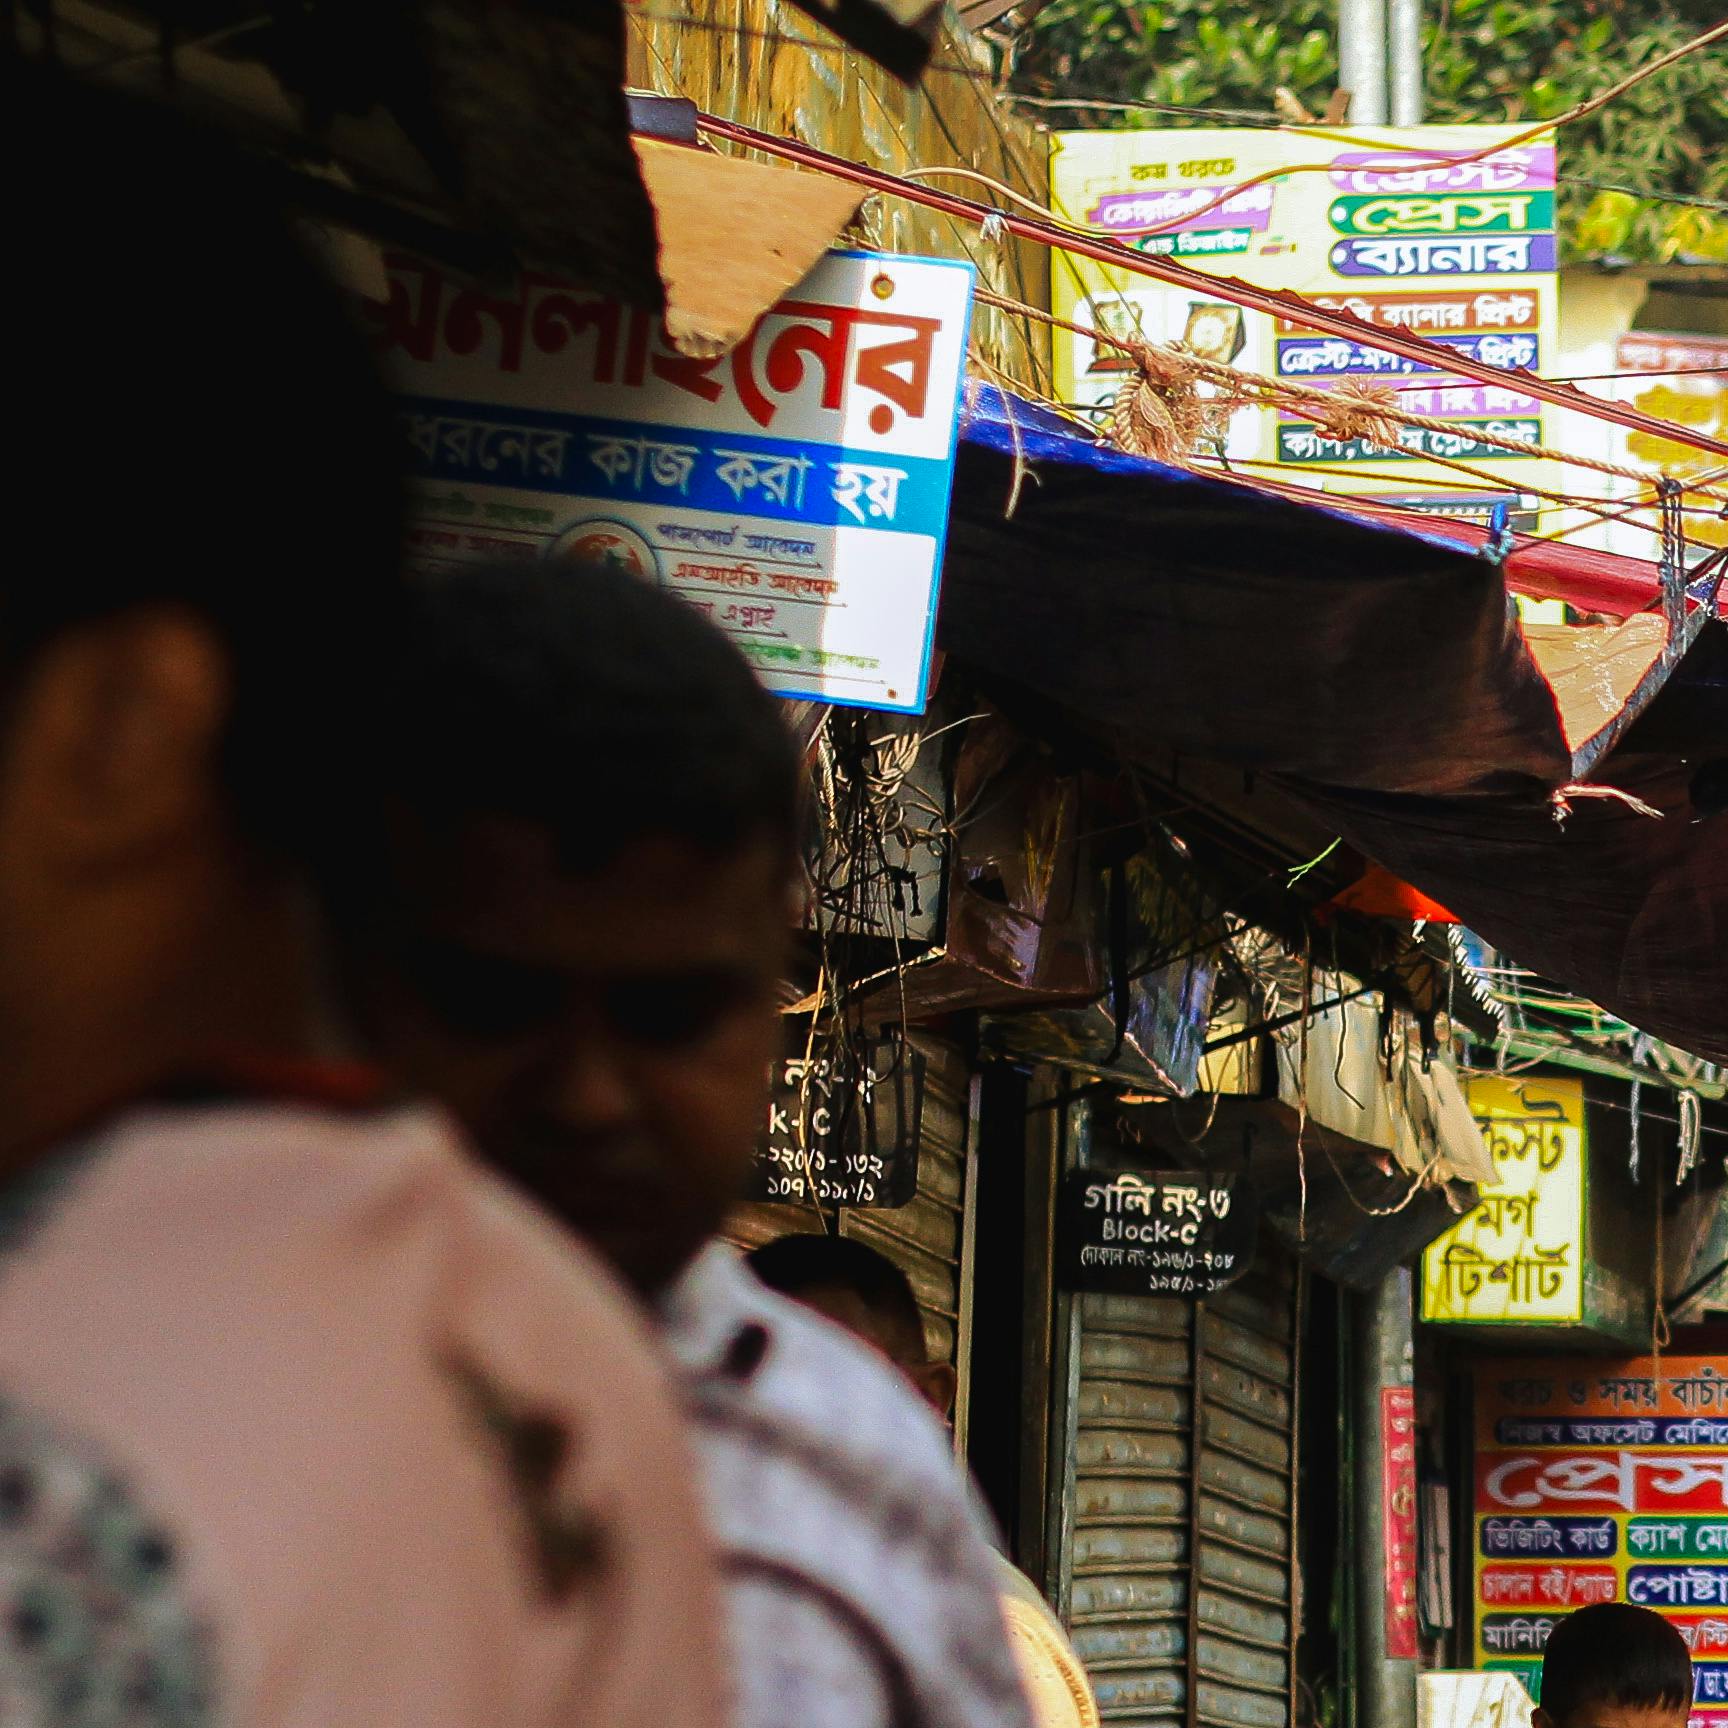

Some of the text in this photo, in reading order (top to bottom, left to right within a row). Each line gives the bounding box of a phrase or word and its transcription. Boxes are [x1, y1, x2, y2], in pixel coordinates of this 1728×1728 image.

[1353, 196, 1532, 232] প্রেস
[1353, 238, 1532, 273] ব্যানার
[587, 434, 701, 498] কাজ
[712, 447, 813, 508] করা
[830, 461, 908, 525] হয়
[1083, 1173, 1157, 1218] গলি
[1476, 1189, 1538, 1238] মগ
[1102, 1217, 1200, 1247] Block-C
[1599, 1376, 1658, 1409] সময়
[1485, 1519, 1613, 1552] ভিজিটিং কার্ড
[1629, 1523, 1688, 1552] ক্যাশ
